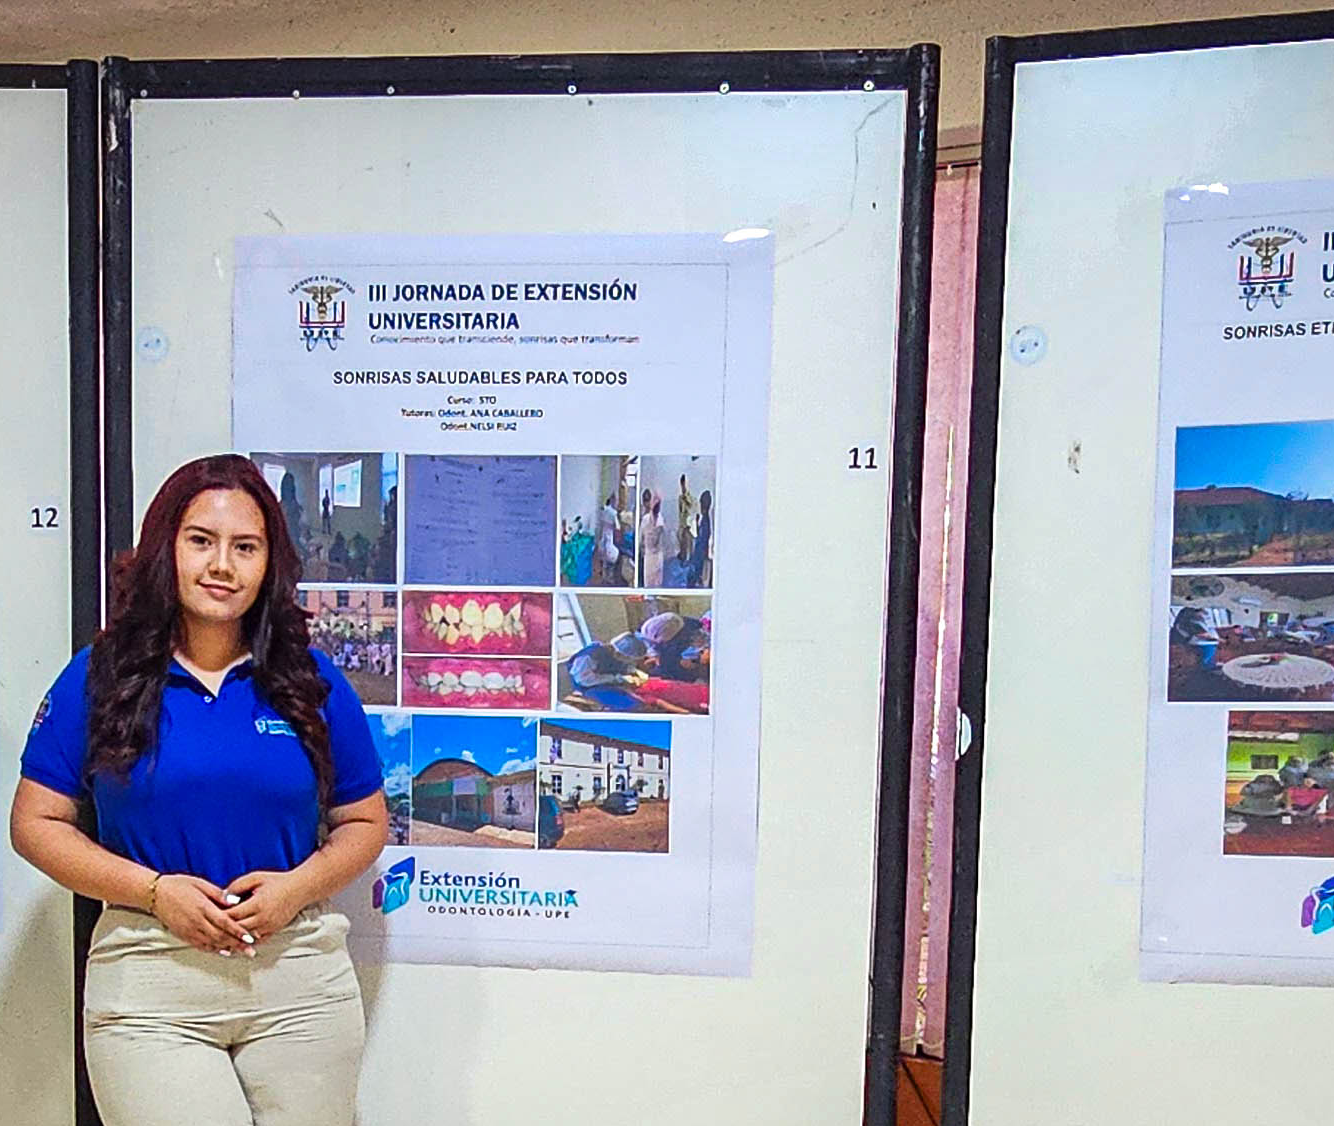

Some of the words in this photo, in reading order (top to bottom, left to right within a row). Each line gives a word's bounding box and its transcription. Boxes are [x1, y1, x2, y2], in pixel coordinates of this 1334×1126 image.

[368, 284, 386, 302] III
[392, 284, 485, 302] JORNADA
[491, 283, 519, 301] DE
[524, 278, 637, 301] EXTENSIÓN
[368, 312, 520, 330] UNIVERSITARIA
[439, 336, 456, 345] que
[560, 335, 579, 345] que
[1222, 322, 1306, 341] SONRISAS
[333, 371, 412, 385] SONRISAS
[416, 371, 521, 385] SALUDABLES
[526, 371, 569, 385] PARA
[572, 371, 628, 385] TODOS
[470, 409, 490, 418] ANA
[848, 447, 878, 469] 11
[31, 507, 59, 528] 12
[420, 870, 521, 889] Extensión
[419, 888, 579, 908] UNIVERSITARIA
[427, 904, 531, 918] ODONTOLOGÍA
[545, 910, 571, 919] UPE
